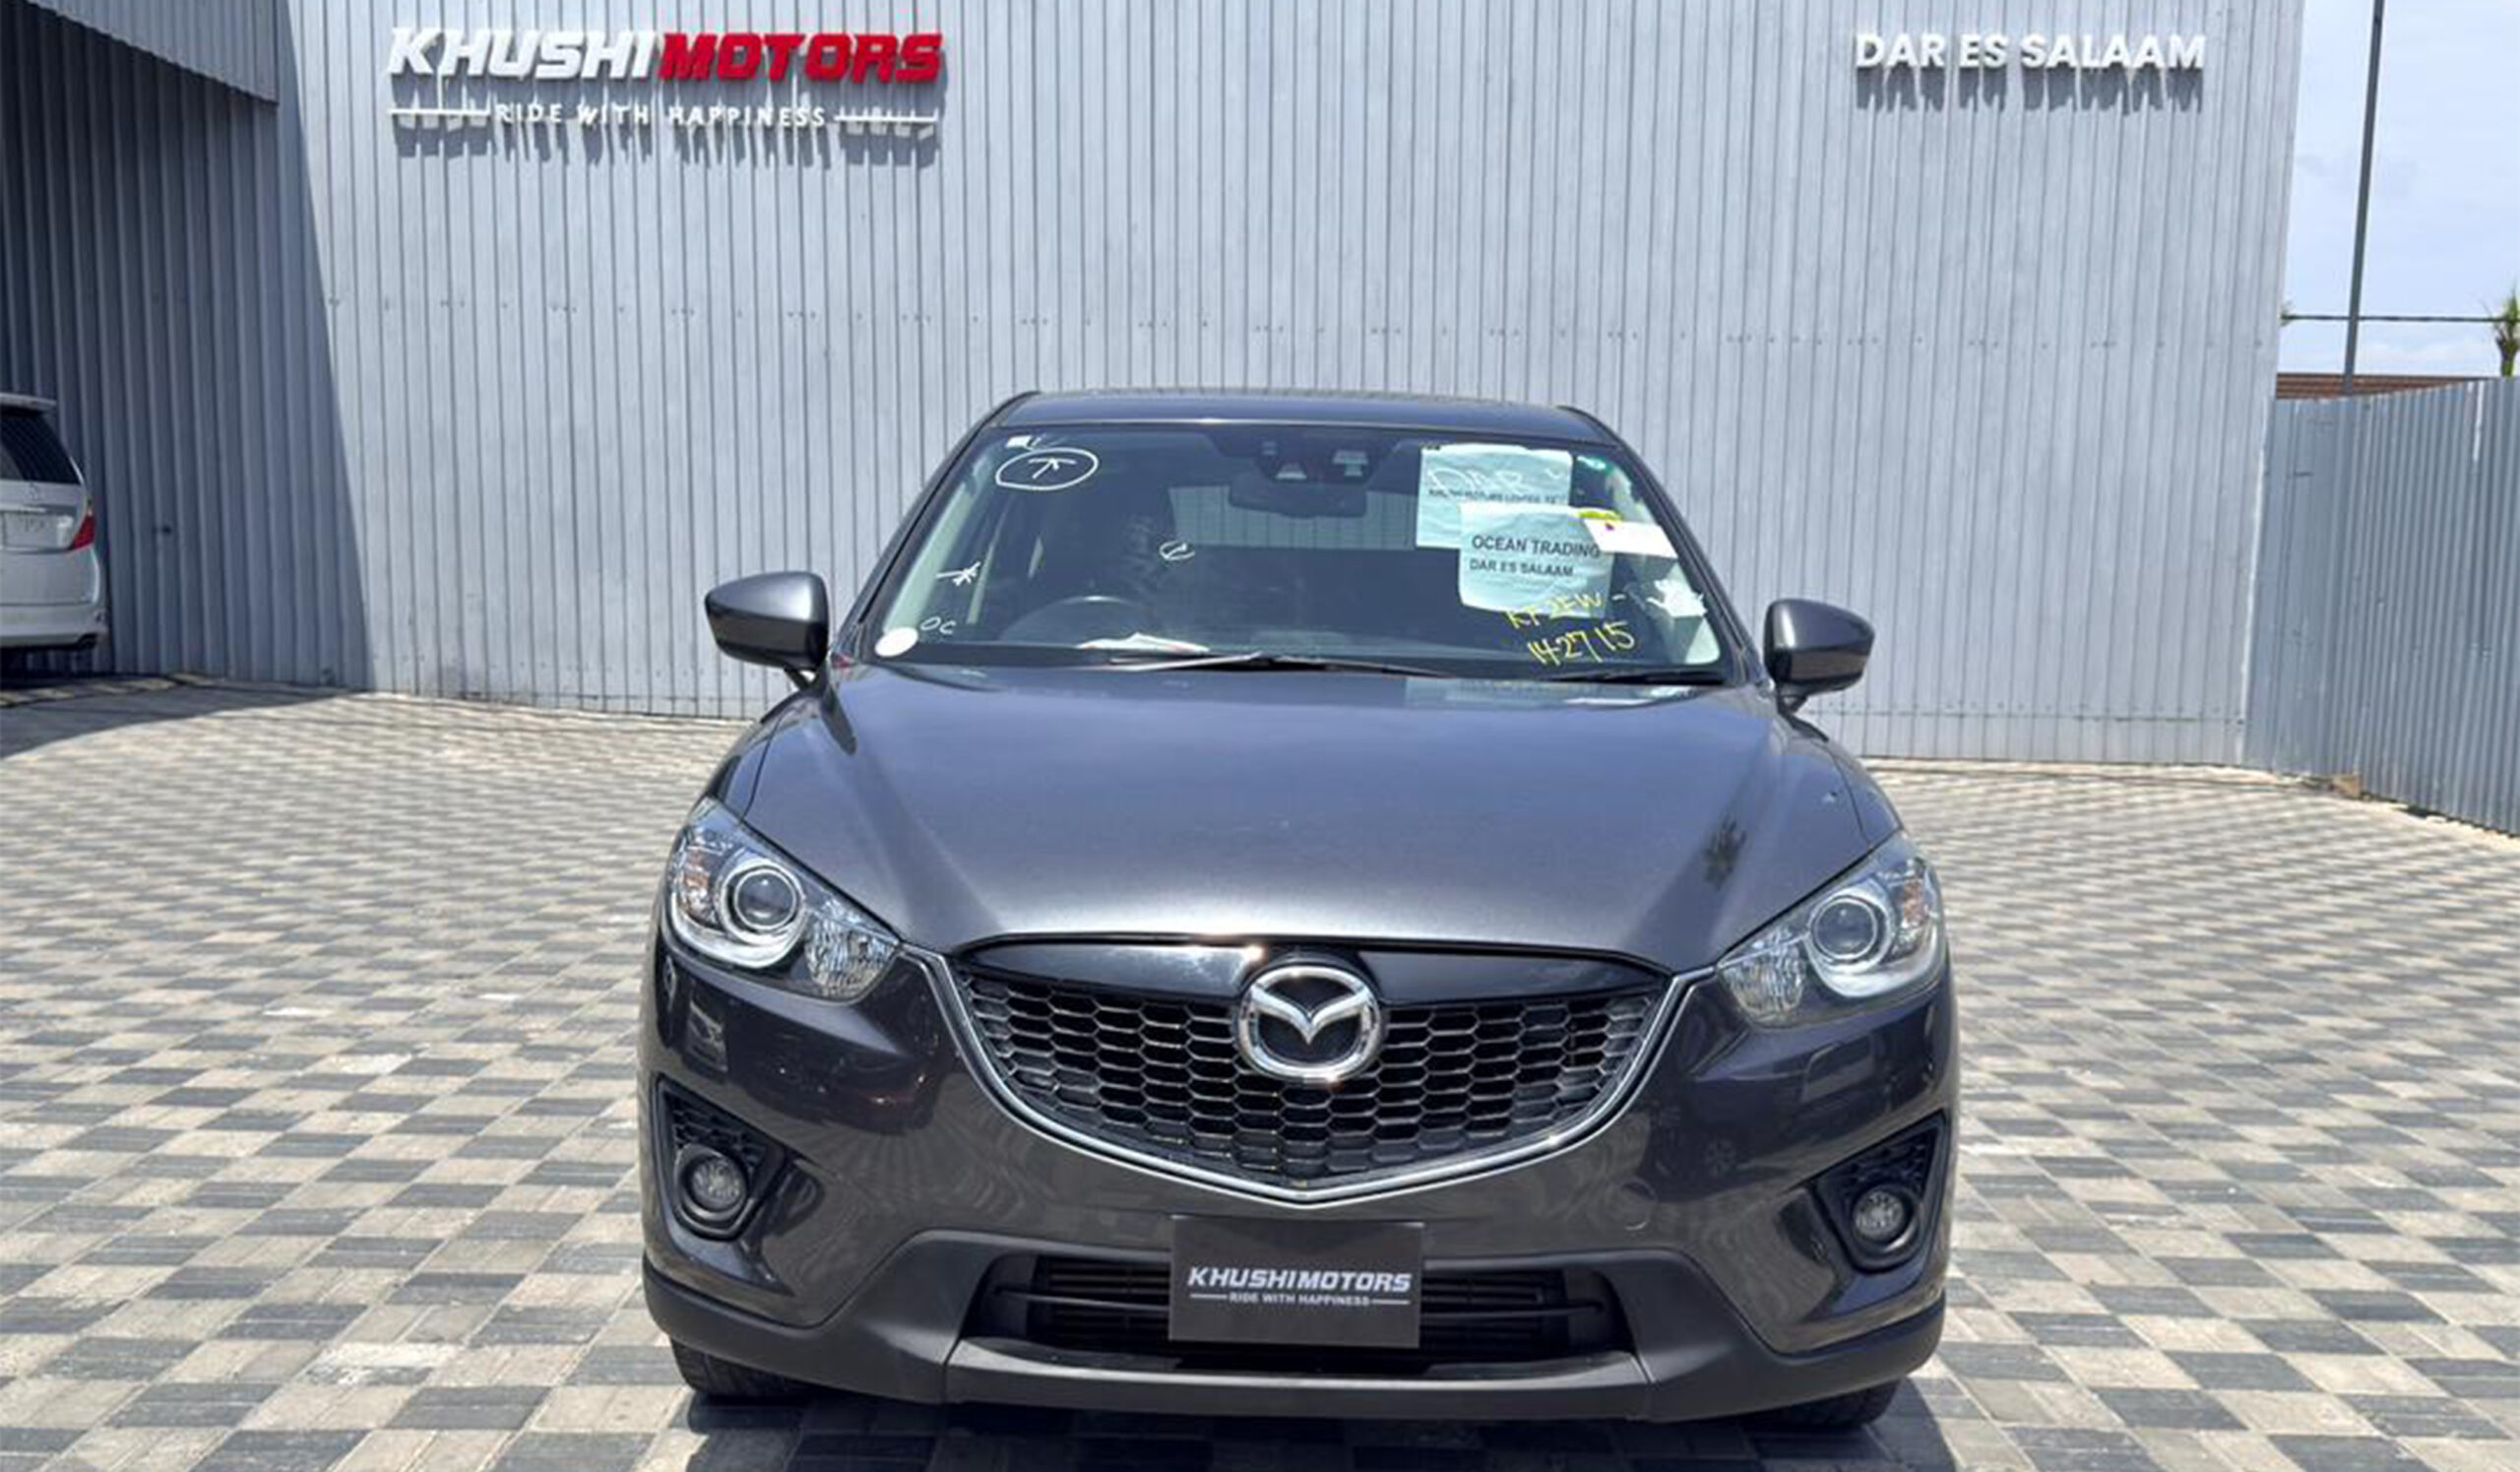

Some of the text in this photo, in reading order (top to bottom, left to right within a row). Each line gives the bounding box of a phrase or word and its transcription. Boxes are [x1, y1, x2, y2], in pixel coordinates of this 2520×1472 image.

[1855, 33, 2207, 69] DAR ES SALAAM
[495, 103, 827, 128] RIDE WITH HAPPINESS
[1472, 535, 1528, 552] OCEAN
[1470, 558, 1574, 577] DAR ES SALAAM
[1229, 1292, 1371, 1307] RIDE WITH HAPPINESS
